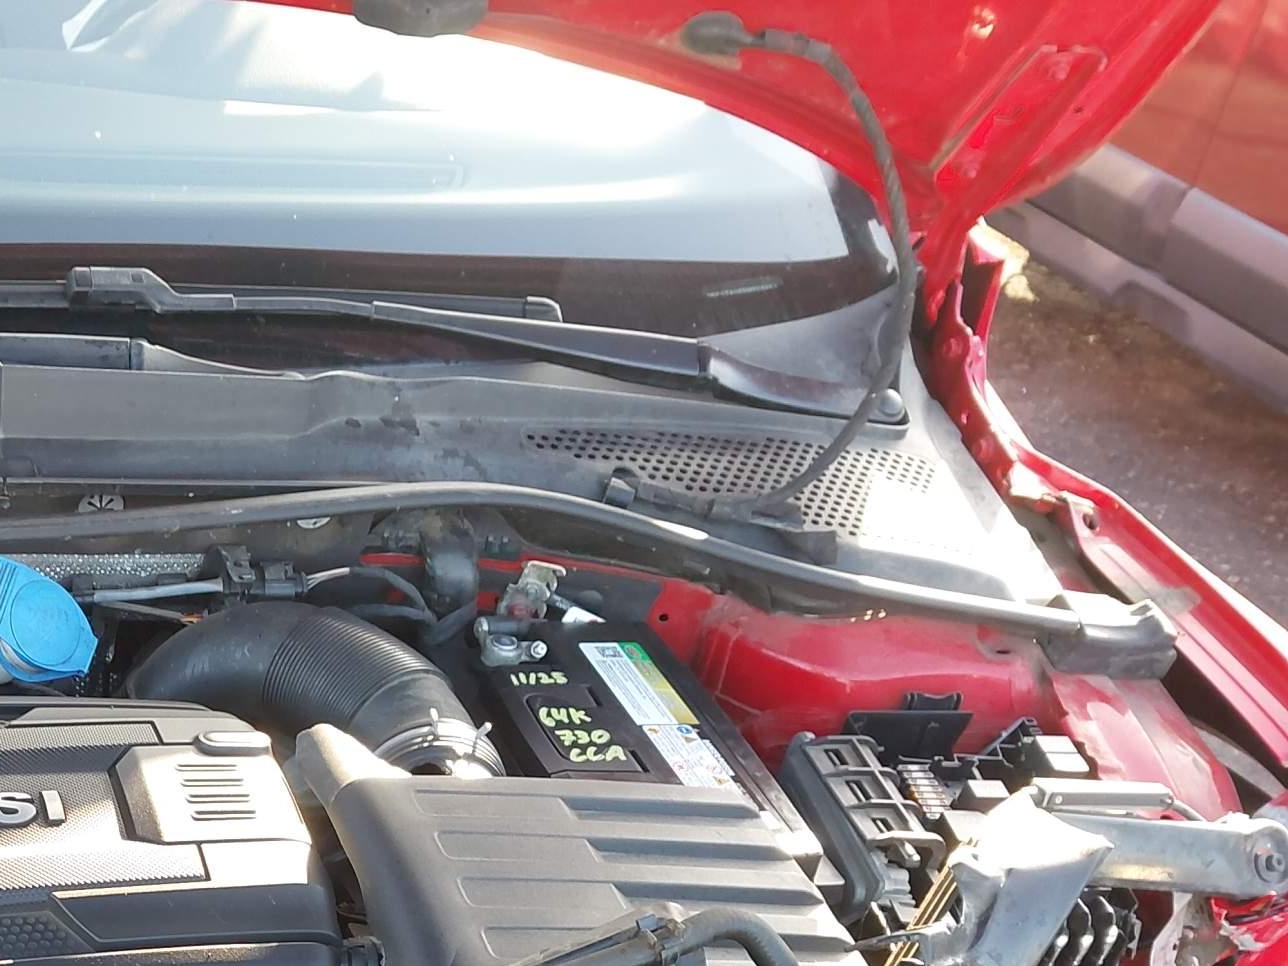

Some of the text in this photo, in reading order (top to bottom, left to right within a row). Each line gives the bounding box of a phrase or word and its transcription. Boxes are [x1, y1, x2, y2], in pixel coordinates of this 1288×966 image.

[510, 672, 568, 686] 11/25
[554, 729, 611, 746] 730
[569, 745, 627, 762] CCA
